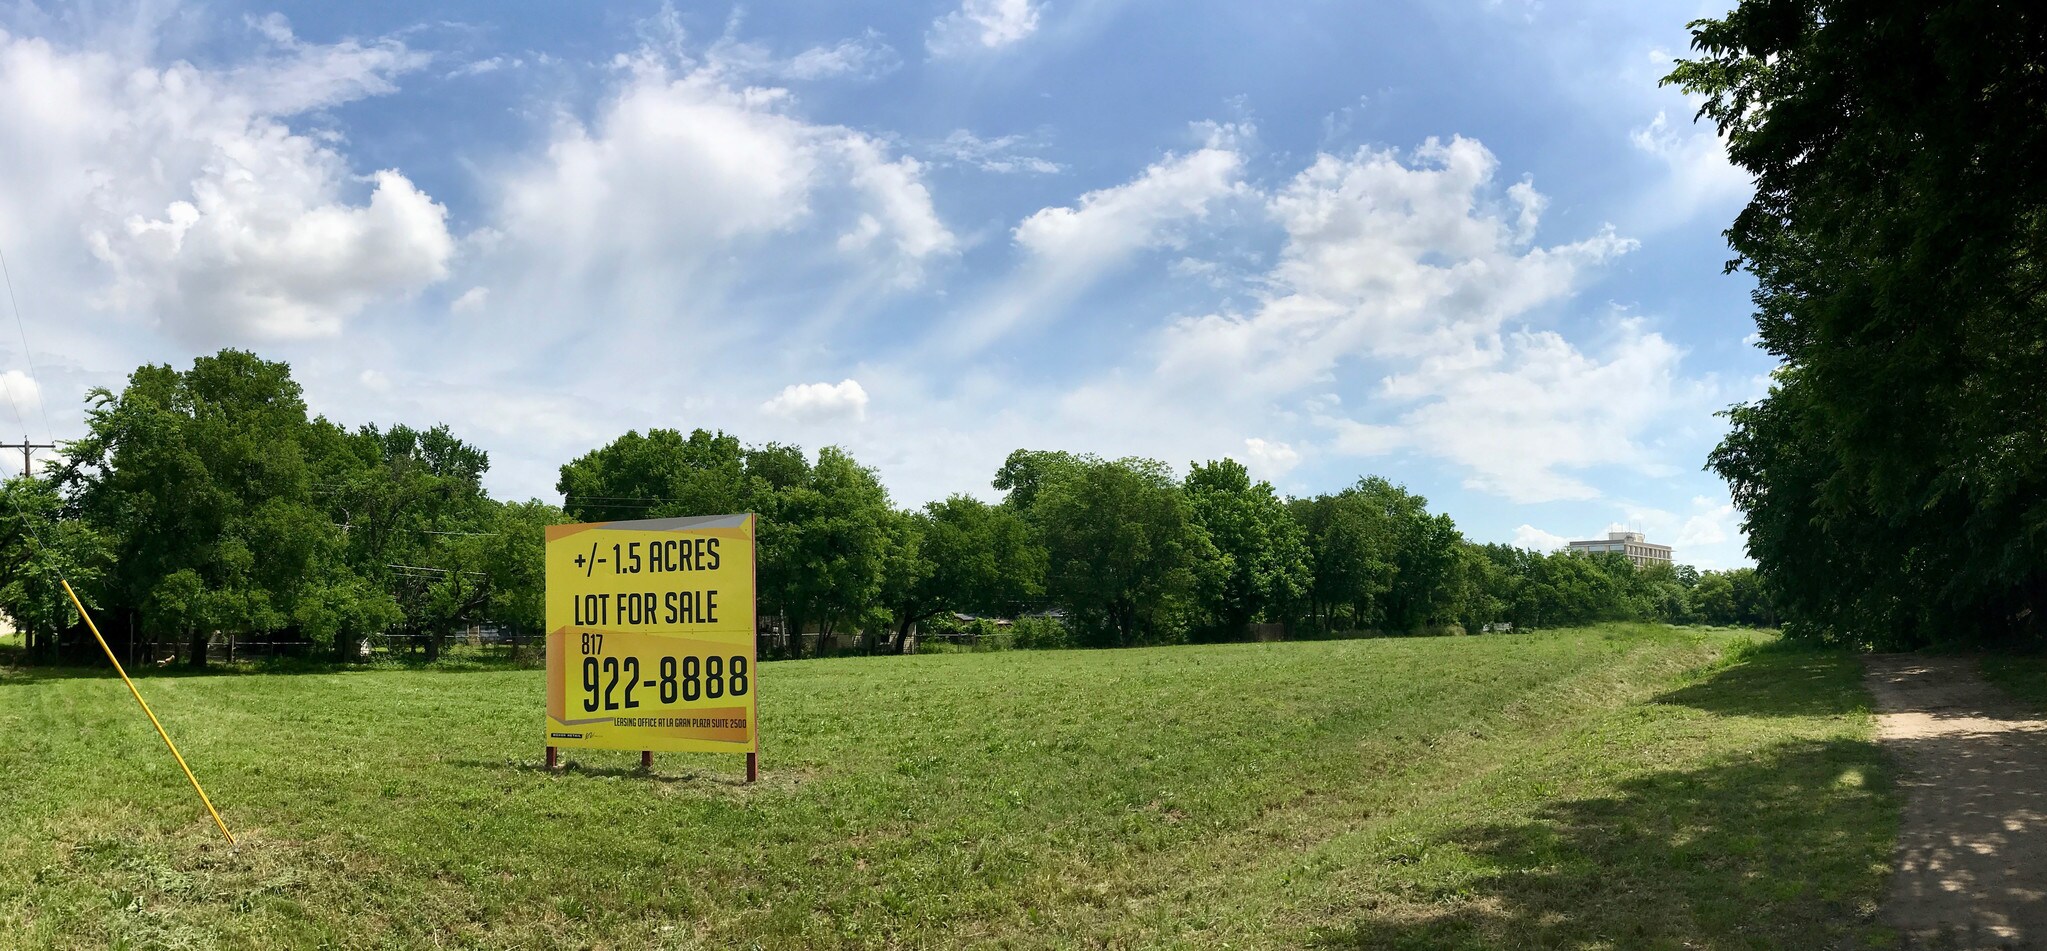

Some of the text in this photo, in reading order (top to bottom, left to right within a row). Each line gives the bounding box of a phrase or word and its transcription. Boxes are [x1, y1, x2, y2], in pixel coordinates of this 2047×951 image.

[574, 538, 720, 577] +/- 1.5 ACRES
[575, 590, 718, 626] LOT FOR SALE
[581, 632, 603, 655] 817
[583, 655, 748, 712] 922-8888
[614, 717, 747, 729] LEASING OFFICE AT LA GRAN PLAZA SUITE 2500
